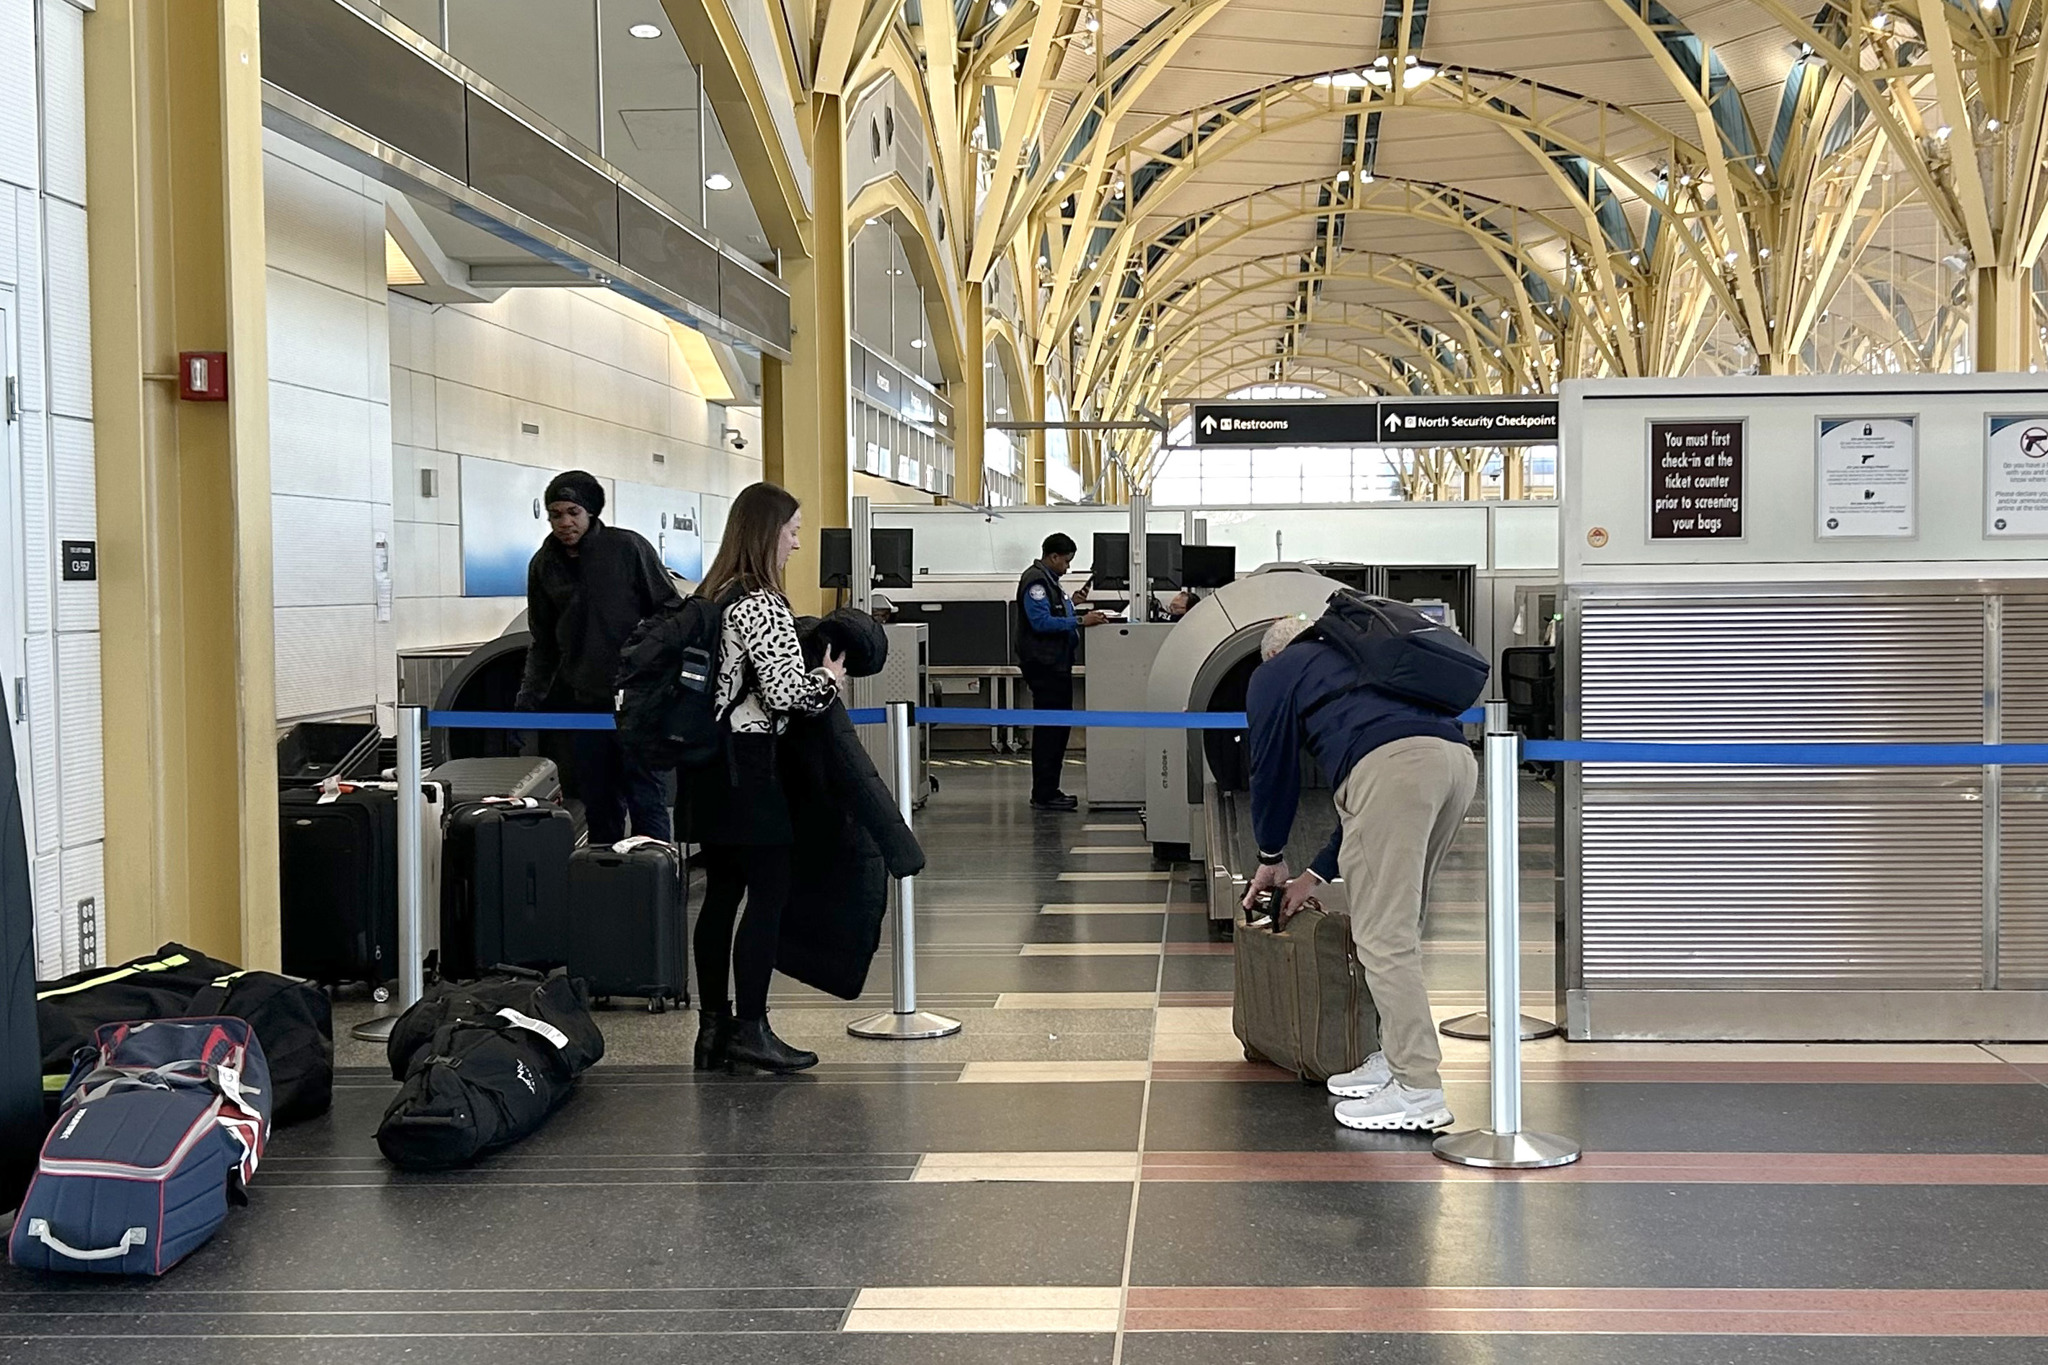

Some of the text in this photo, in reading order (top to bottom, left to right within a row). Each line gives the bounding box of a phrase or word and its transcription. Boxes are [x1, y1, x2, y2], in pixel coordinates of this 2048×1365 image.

[1233, 419, 1289, 430] Restrooms
[1418, 414, 1556, 429] North Security Checkpoint
[1664, 429, 1731, 447] You must first
[1661, 451, 1733, 468] check-in at the
[1665, 472, 1730, 489] ticket counter
[1655, 493, 1739, 513] prior to screening
[1672, 513, 1722, 534] your bags
